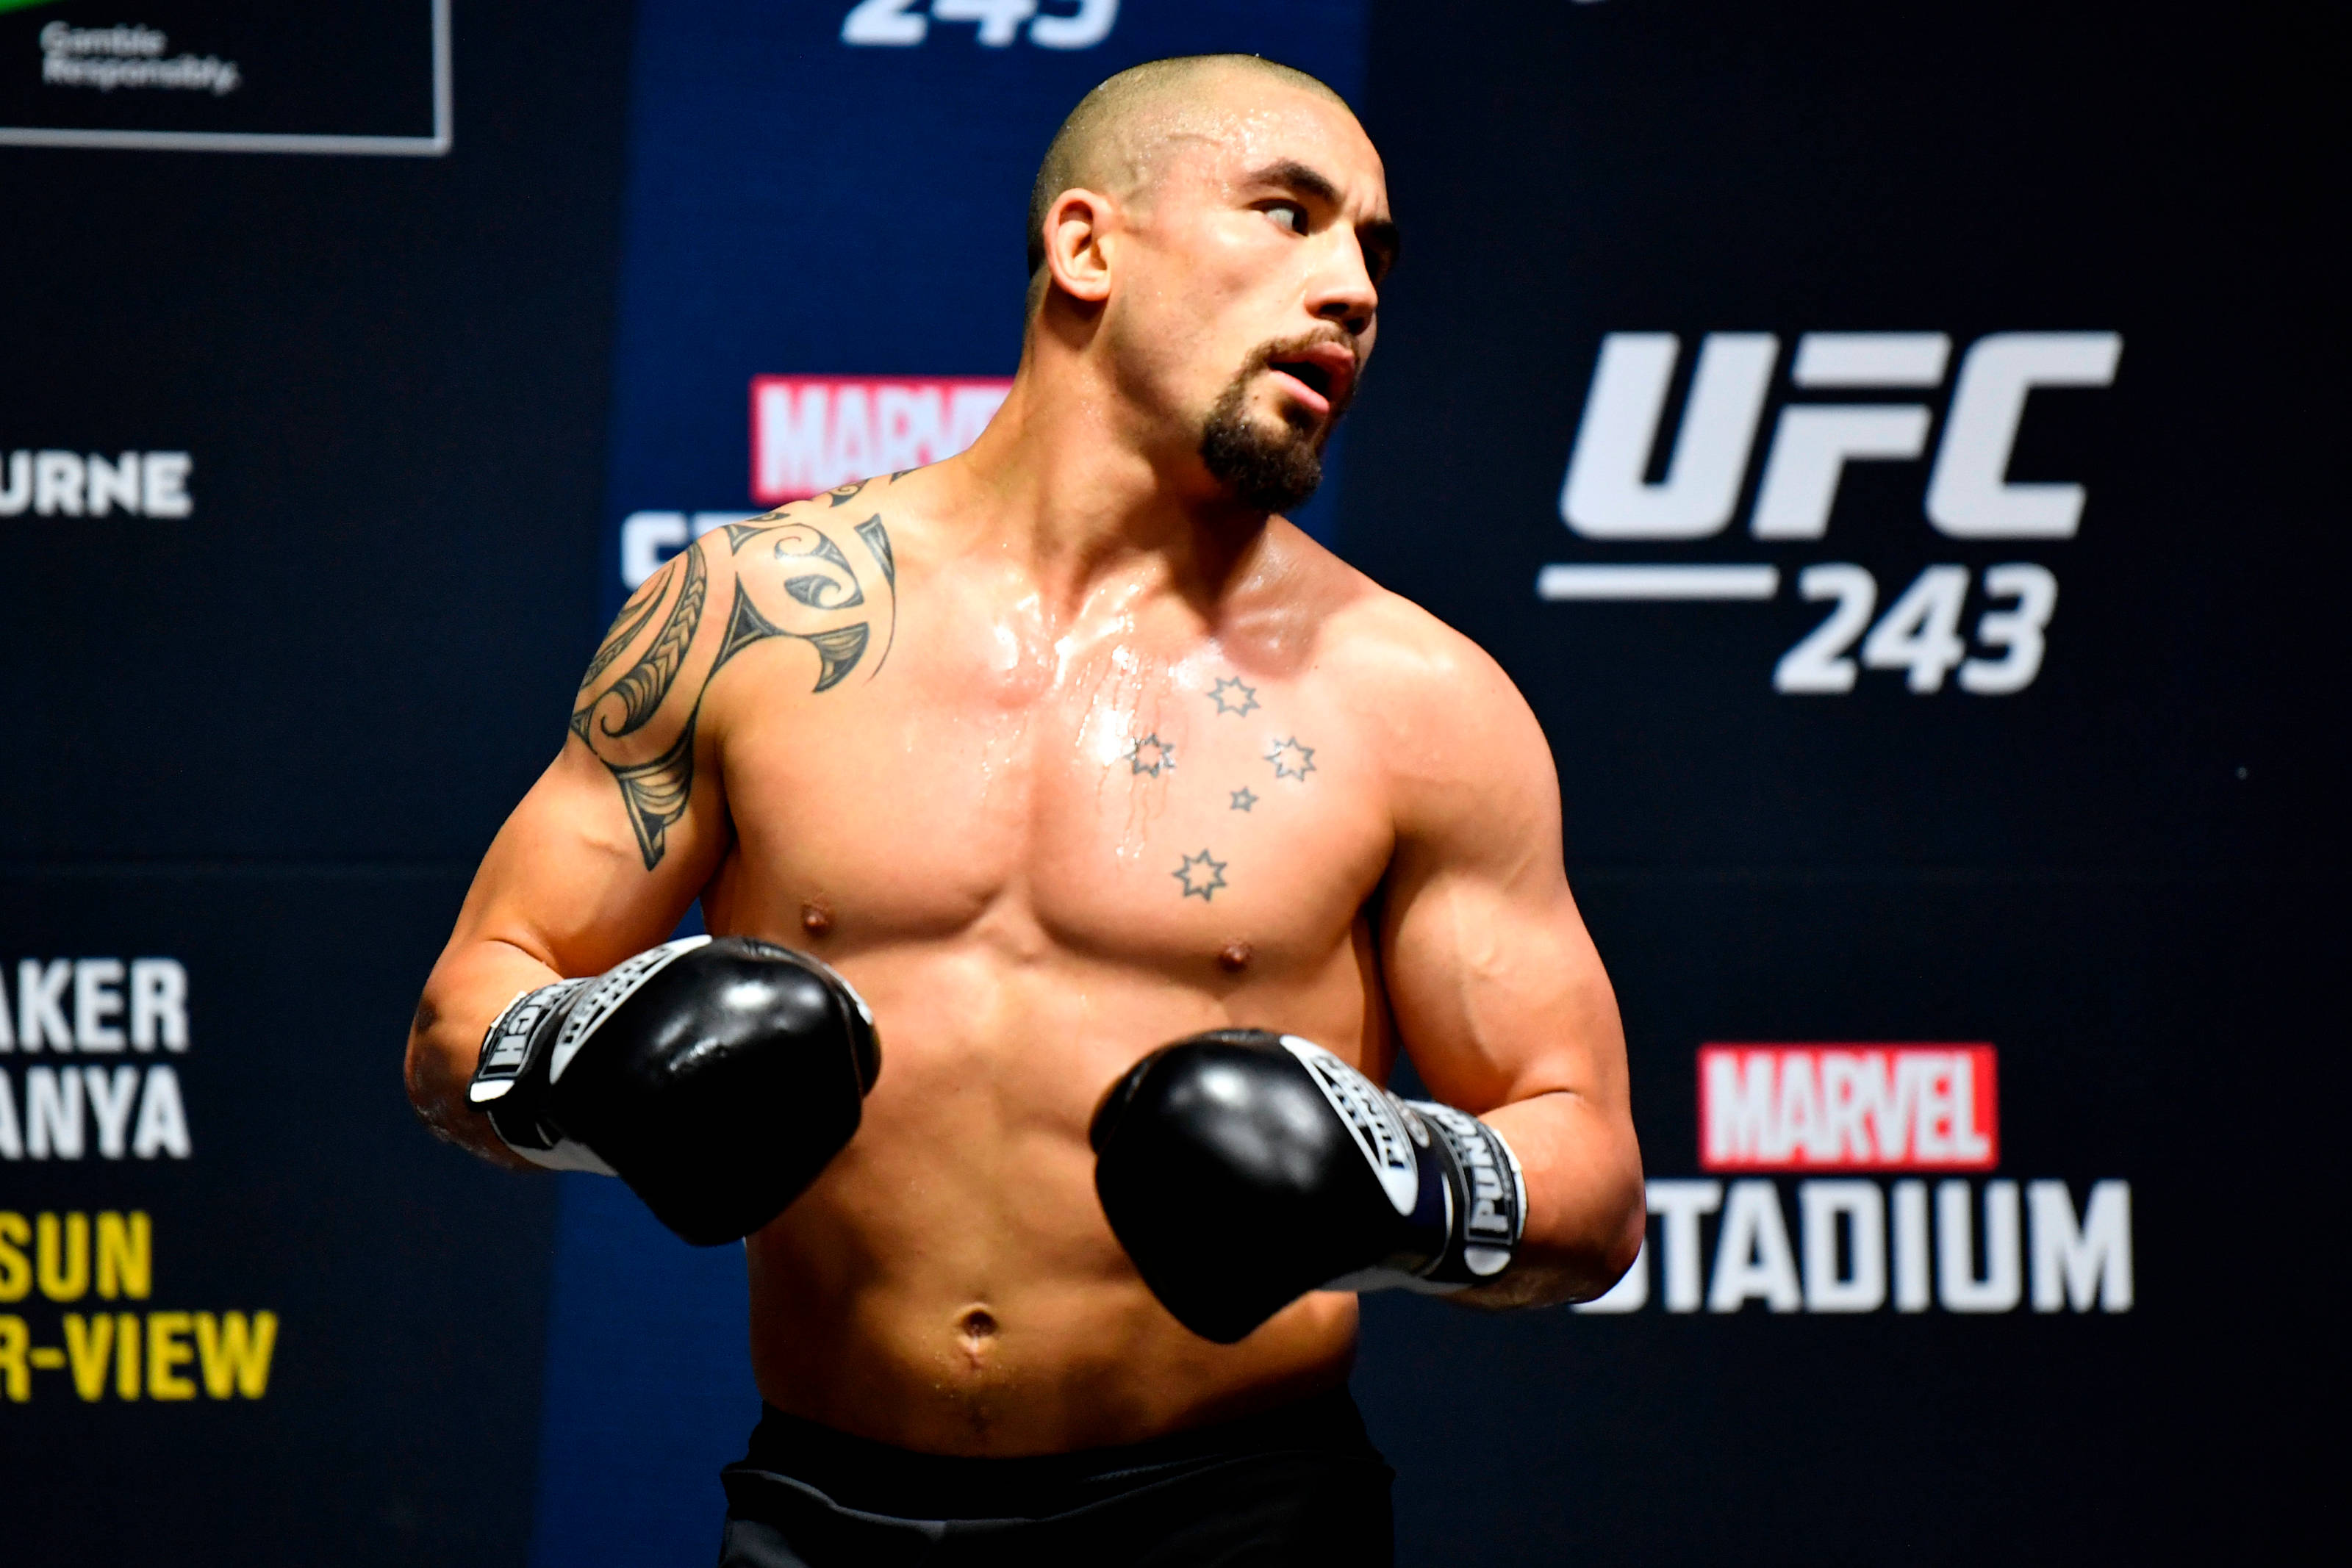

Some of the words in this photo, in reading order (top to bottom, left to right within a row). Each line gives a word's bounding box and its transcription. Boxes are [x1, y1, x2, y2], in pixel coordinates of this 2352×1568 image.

[759, 383, 1011, 491] MARV
[1558, 331, 2123, 540] UFC
[1773, 563, 2058, 694] 243
[0, 957, 189, 1052] KER
[1707, 1054, 1990, 1161] MARVEL
